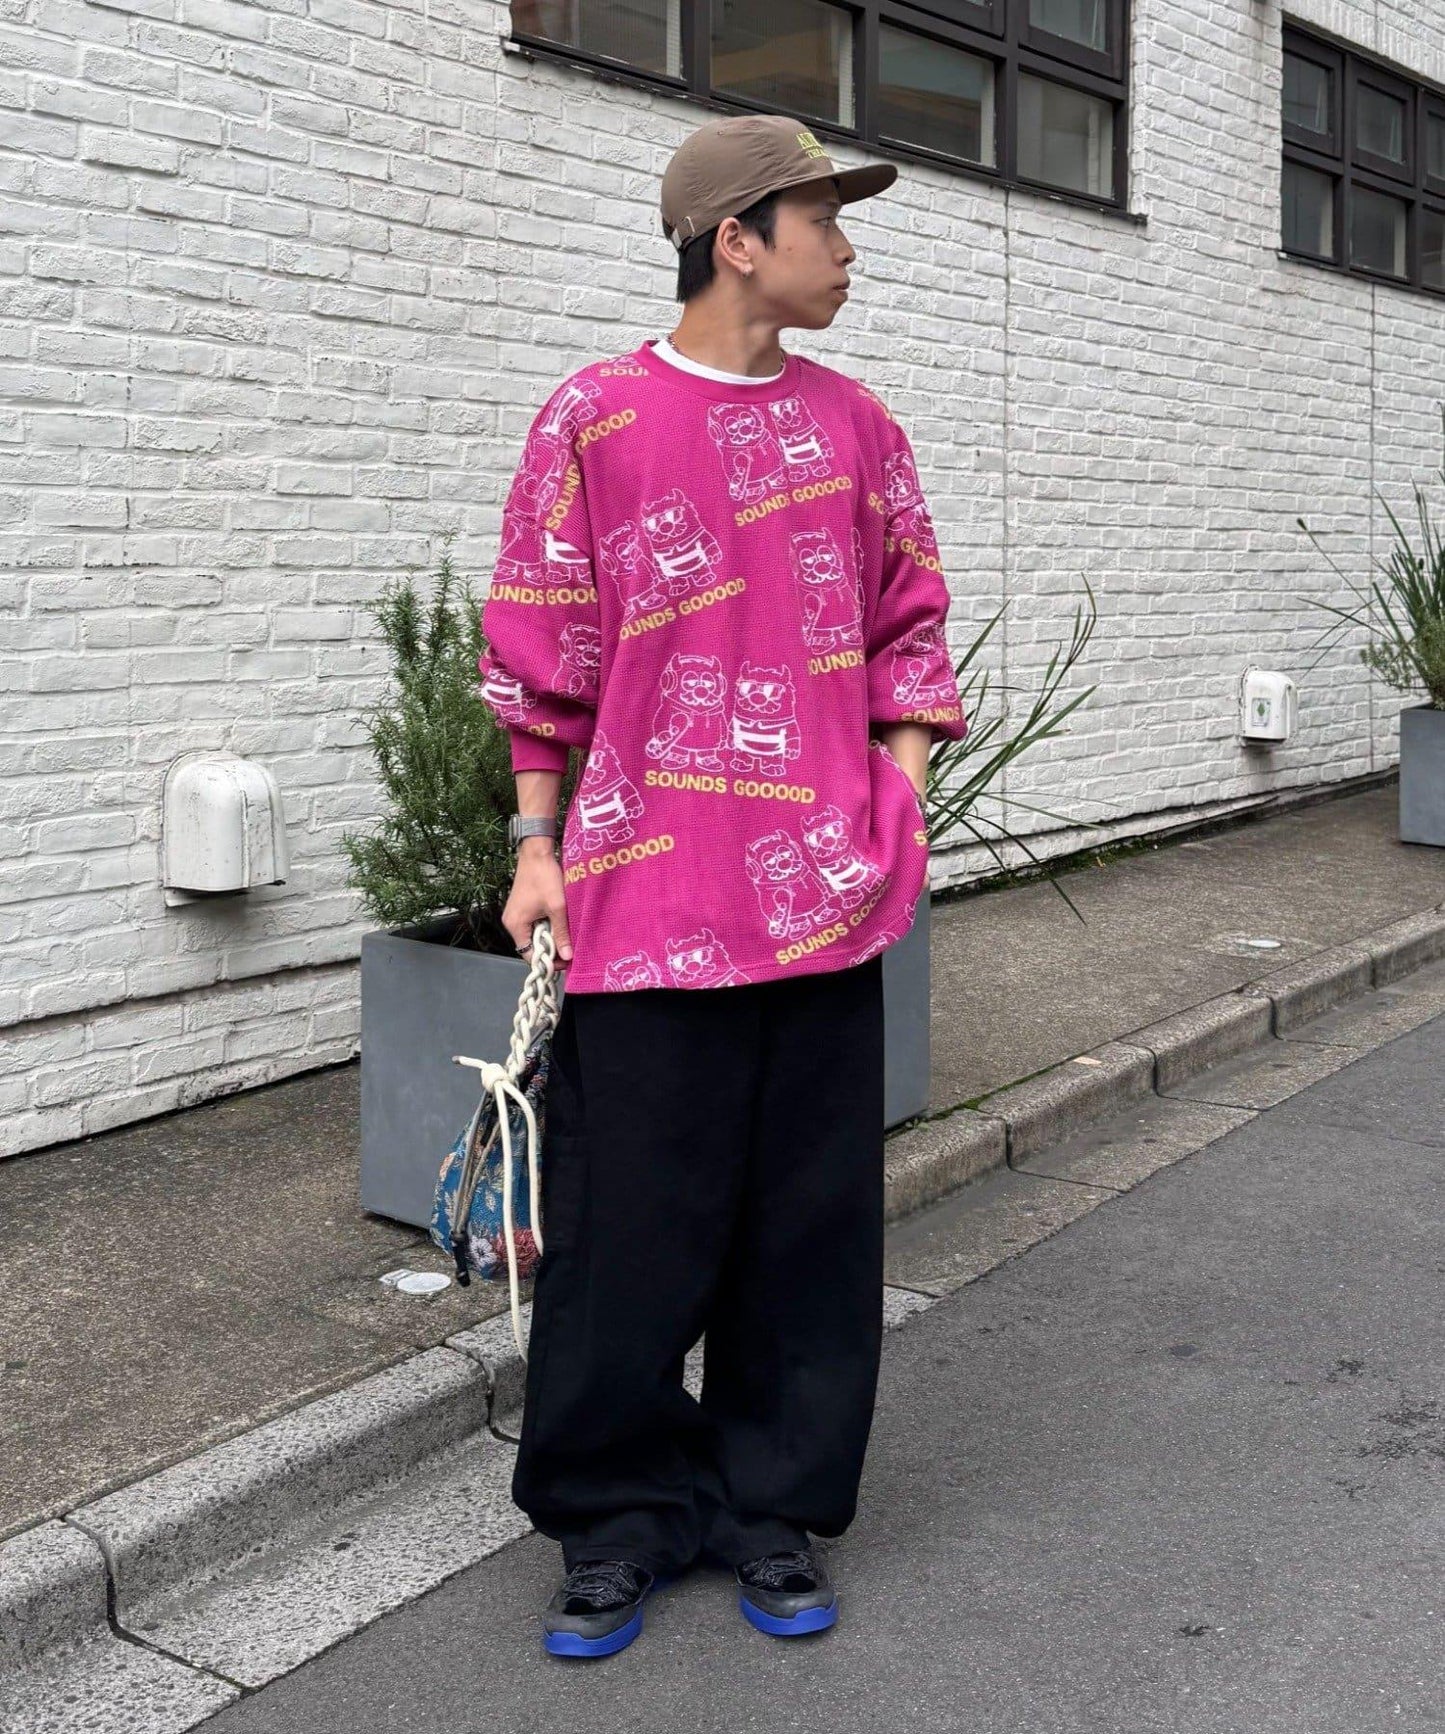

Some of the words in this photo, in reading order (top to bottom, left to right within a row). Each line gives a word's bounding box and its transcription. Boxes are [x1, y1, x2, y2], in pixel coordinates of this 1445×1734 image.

[678, 577, 747, 615] GOOOOD
[644, 769, 728, 794] SOUNDS
[733, 779, 816, 805] GOOOOD
[588, 834, 675, 876] GOOOOD
[775, 922, 849, 966] SOUNDS
